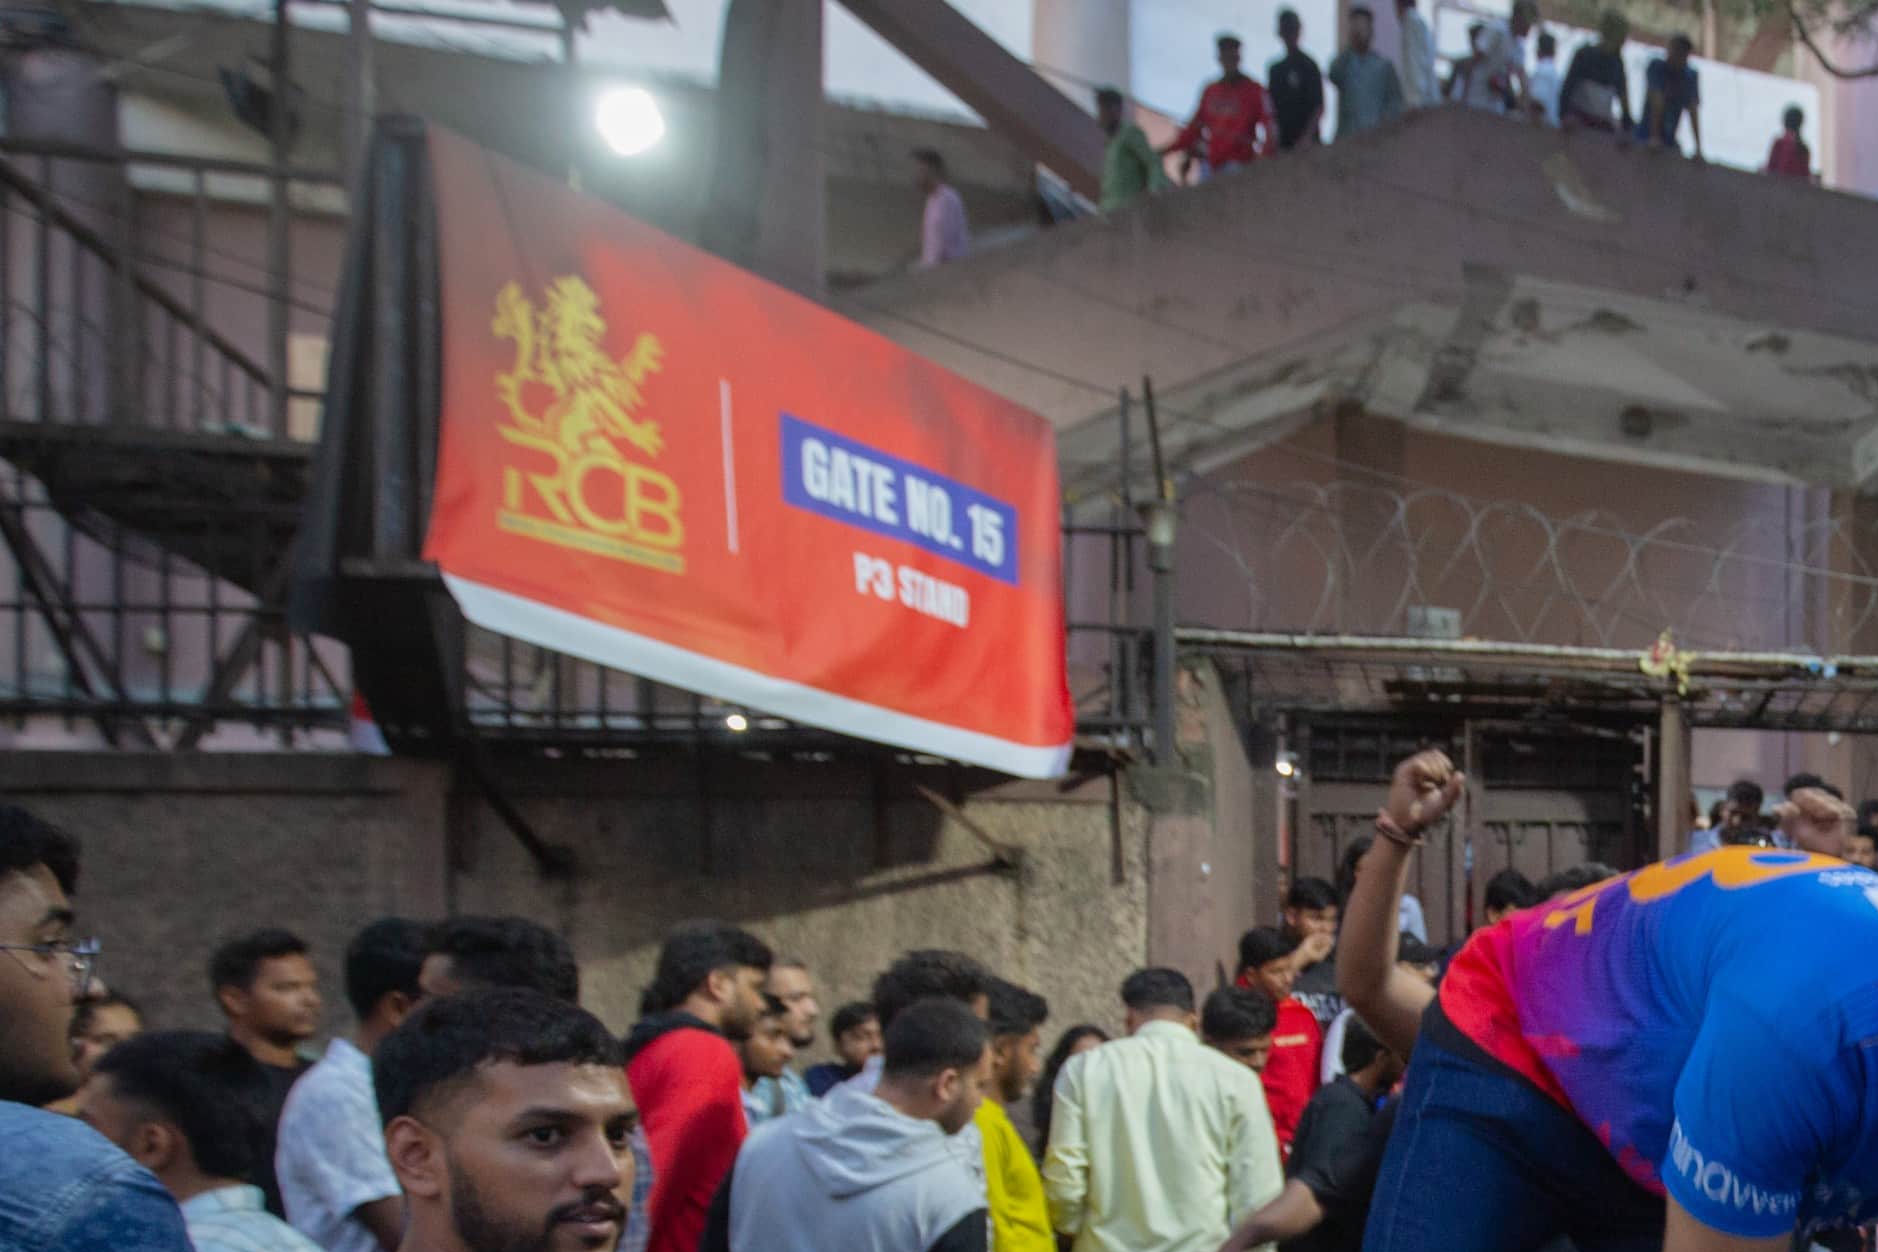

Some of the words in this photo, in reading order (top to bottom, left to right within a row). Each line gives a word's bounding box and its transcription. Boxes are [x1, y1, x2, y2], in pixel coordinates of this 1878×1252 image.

[496, 426, 686, 548] RCB
[801, 436, 900, 526] GATE
[904, 474, 965, 551] NO.
[966, 502, 1005, 567] 15
[853, 551, 895, 602] P3
[897, 564, 971, 629] STAND
